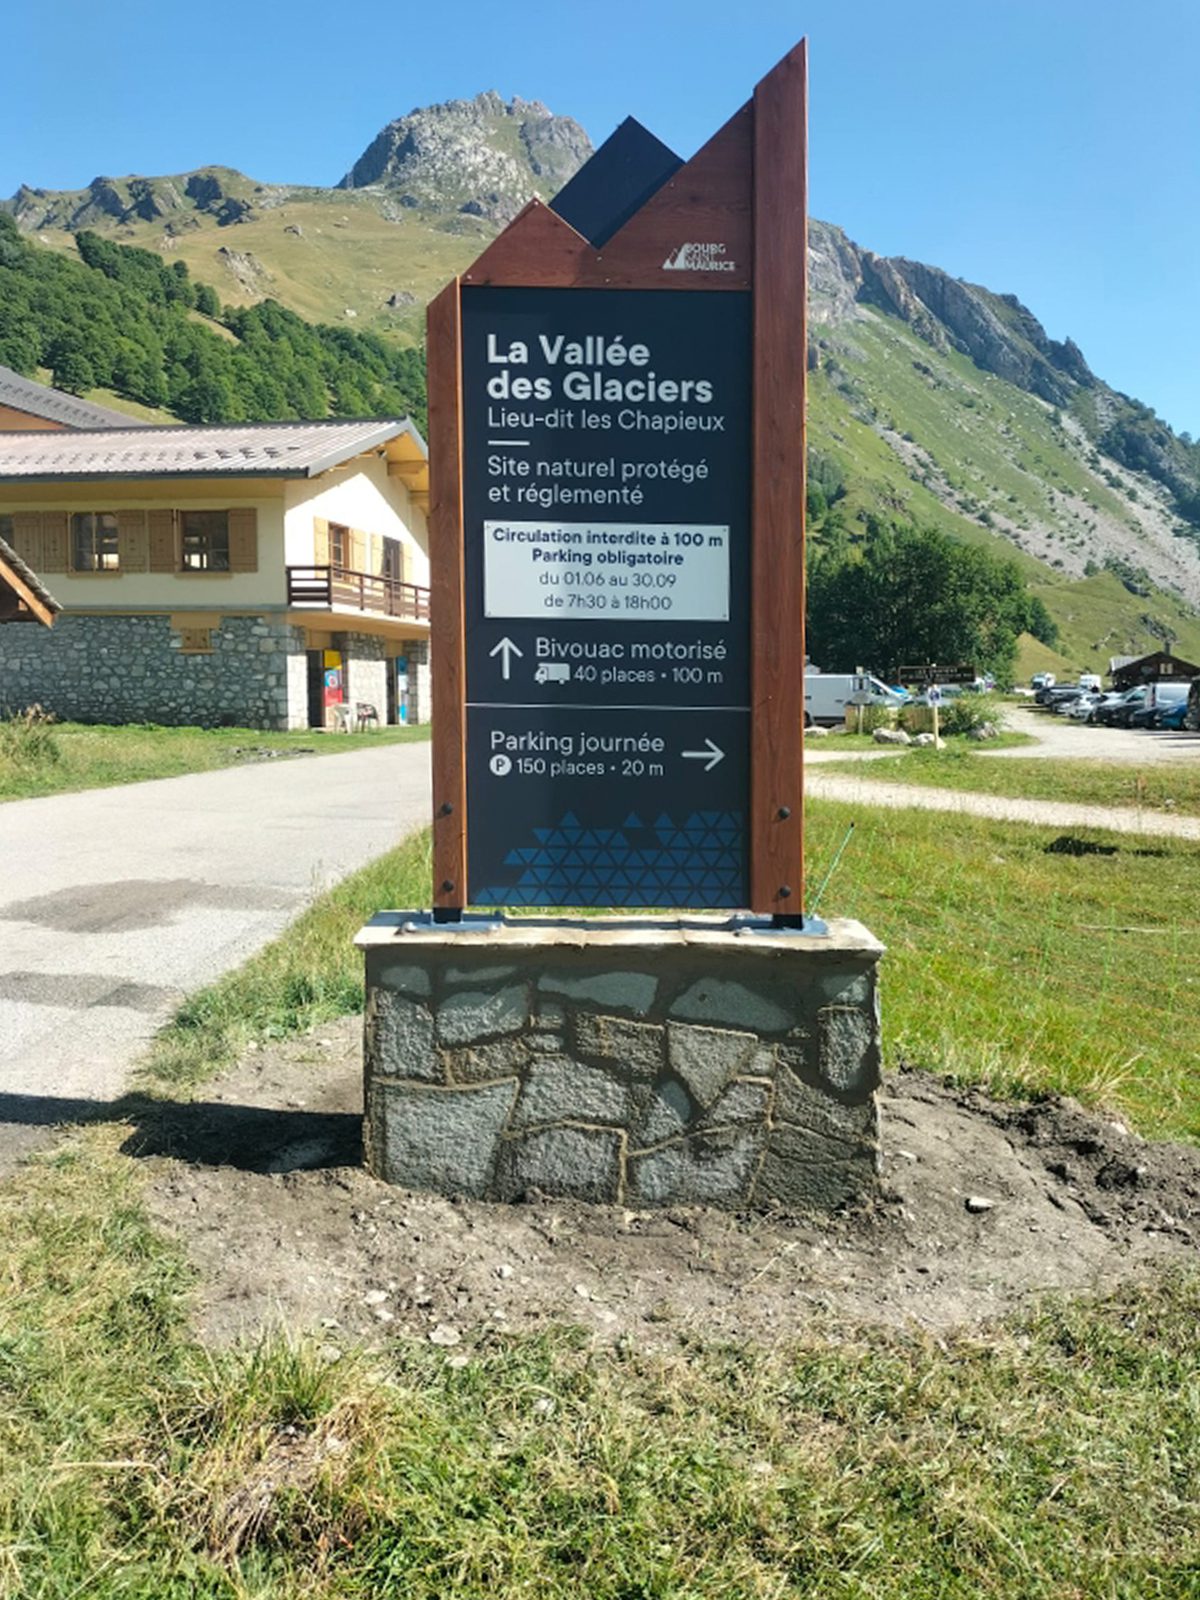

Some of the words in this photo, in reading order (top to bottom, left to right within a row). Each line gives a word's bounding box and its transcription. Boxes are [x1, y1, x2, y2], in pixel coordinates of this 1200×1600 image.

[486, 333, 529, 364] La
[538, 334, 650, 366] Vallée
[486, 370, 552, 400] des
[562, 371, 713, 403] Glaciers
[488, 406, 574, 429] Lieu-dit
[581, 408, 612, 430] les
[618, 408, 725, 434] Chapieux
[487, 455, 530, 476] Site
[536, 457, 615, 478] naturel
[621, 458, 709, 483] protégé
[488, 484, 510, 502] et
[517, 484, 644, 507] réglementé
[493, 528, 582, 544] Circulation
[587, 530, 656, 545] interdite
[661, 532, 669, 546] à
[674, 532, 704, 546] 100
[708, 535, 723, 547] m
[532, 548, 592, 566] Parking
[597, 549, 684, 567] obligatoire
[539, 571, 559, 586] du
[609, 573, 628, 586] au
[632, 573, 676, 587] 30.09
[544, 594, 564, 608] de
[568, 594, 606, 609] 7h30
[611, 596, 620, 609] à
[625, 596, 672, 610] 18h00
[535, 637, 624, 658] Bivouac
[631, 639, 727, 660] motorisé
[573, 665, 597, 682] 40
[601, 666, 655, 684] places
[672, 668, 702, 684] 100
[707, 671, 723, 684] m
[490, 731, 573, 756] Parking
[579, 732, 665, 756] journée
[517, 758, 546, 774] 150
[550, 758, 605, 777] places
[622, 760, 644, 776] 20
[649, 763, 663, 776] m
